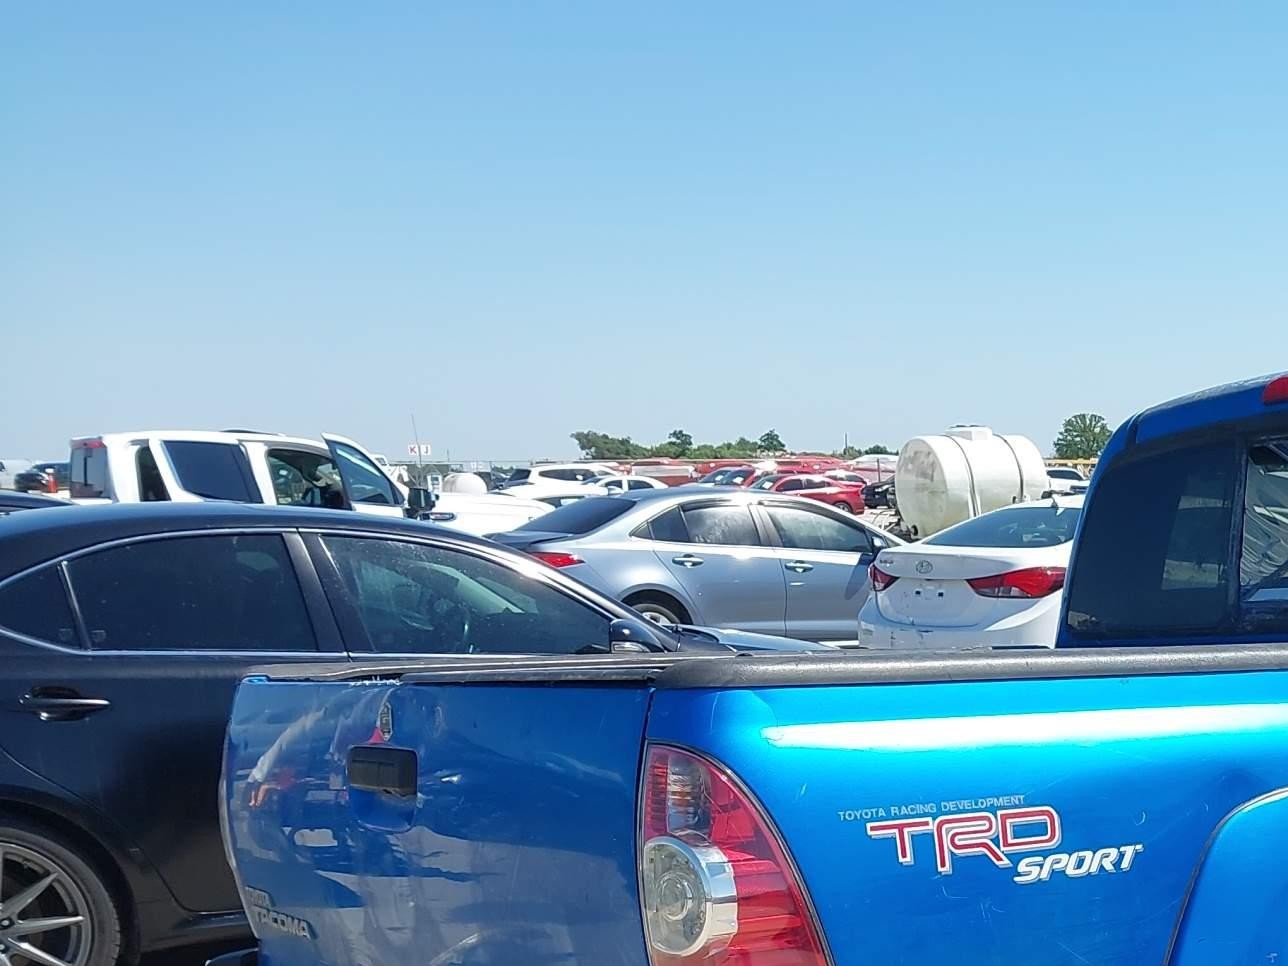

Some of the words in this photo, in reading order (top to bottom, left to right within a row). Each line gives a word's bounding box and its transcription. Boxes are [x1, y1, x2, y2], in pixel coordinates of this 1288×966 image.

[838, 807, 886, 822] TOYOTA
[890, 802, 937, 818] RACING
[941, 794, 1025, 812] DEVELOPMENT
[866, 804, 1060, 875] TRD
[1013, 843, 1144, 885] SPORT
[252, 905, 311, 938] TACOMA
